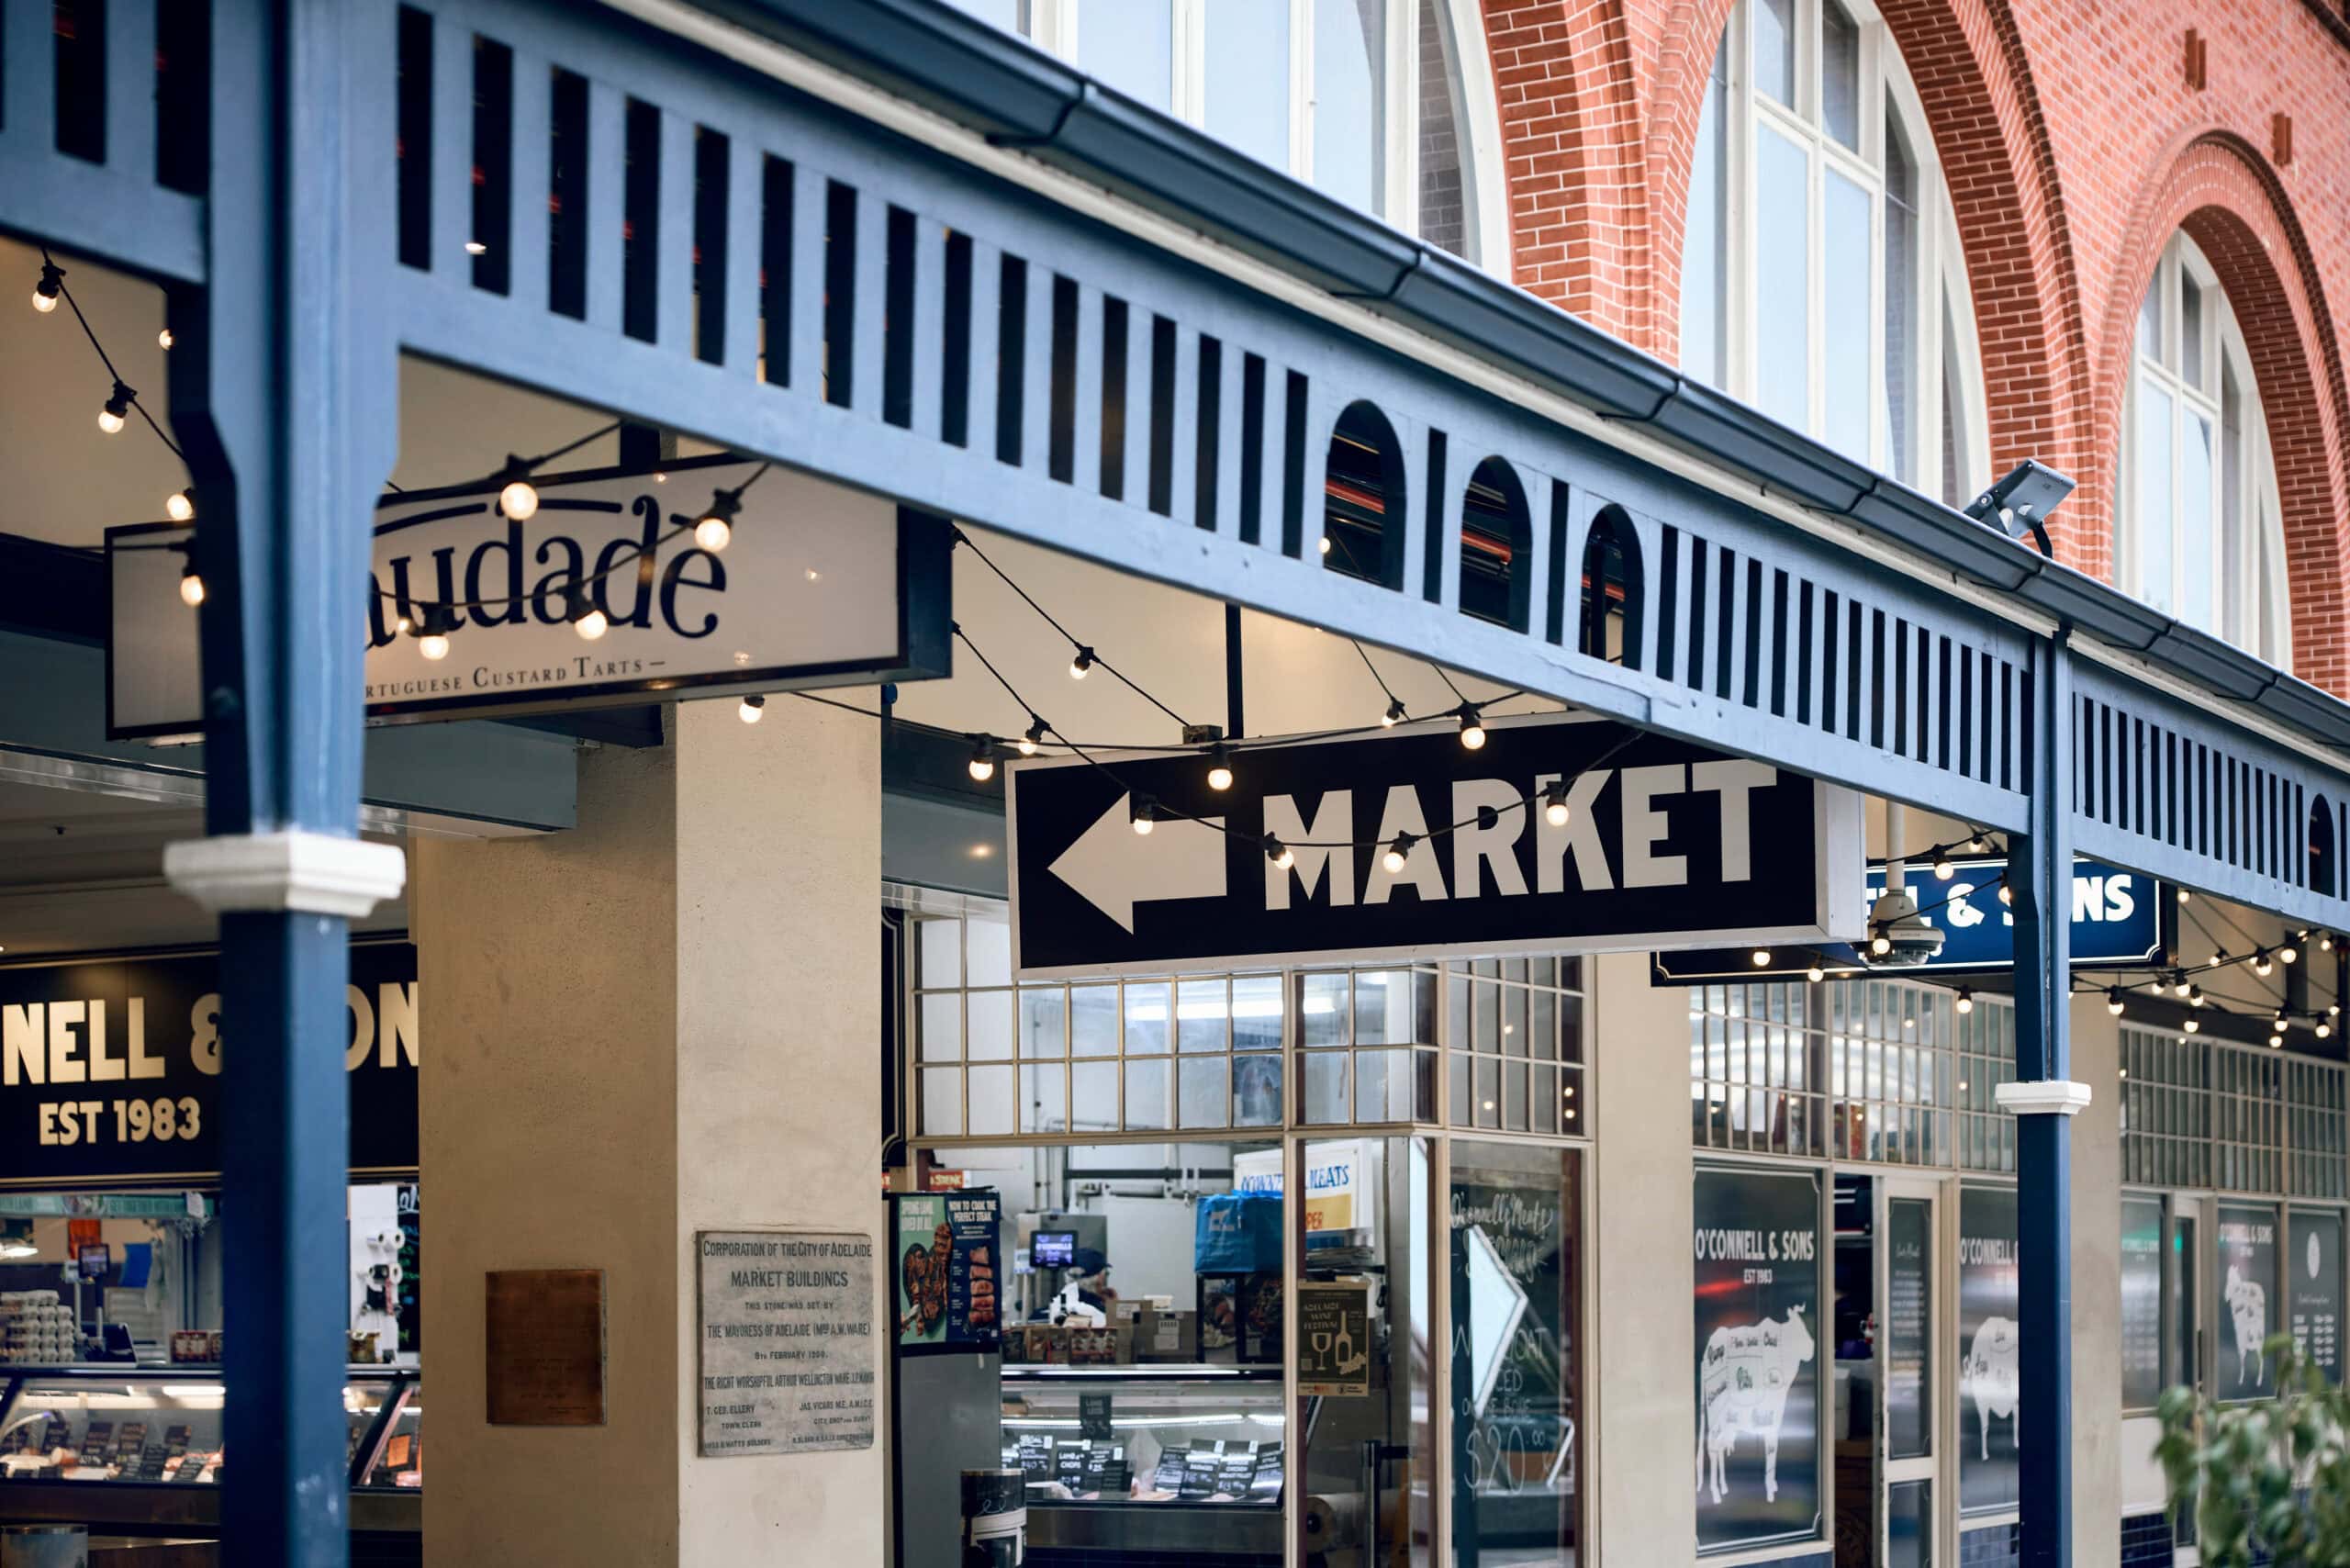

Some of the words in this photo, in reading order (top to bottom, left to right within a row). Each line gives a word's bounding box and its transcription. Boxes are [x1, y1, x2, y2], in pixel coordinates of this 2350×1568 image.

[473, 666, 567, 688] CUSTARD
[573, 656, 642, 678] TARTS
[1262, 758, 1778, 911] MARKET
[1946, 882, 1986, 928] &
[2, 996, 166, 1087] NELL
[39, 1101, 104, 1146] EST
[113, 1096, 201, 1142] 1983
[703, 1239, 766, 1257] CORPORATION
[767, 1242, 778, 1257] OF
[782, 1242, 798, 1257] THE
[798, 1240, 817, 1257] CITY
[818, 1242, 830, 1257] OF
[830, 1241, 873, 1258] ADELAIDE
[1695, 1228, 1765, 1260] O'CONNELL
[1768, 1231, 1779, 1260] &
[1782, 1230, 1814, 1261] SONS
[1960, 1238, 2012, 1264] O'CONNELL
[731, 1270, 783, 1287] MARKET
[786, 1271, 849, 1288] BUILDINGS
[1743, 1269, 1755, 1284] EST
[707, 1325, 722, 1338] THE
